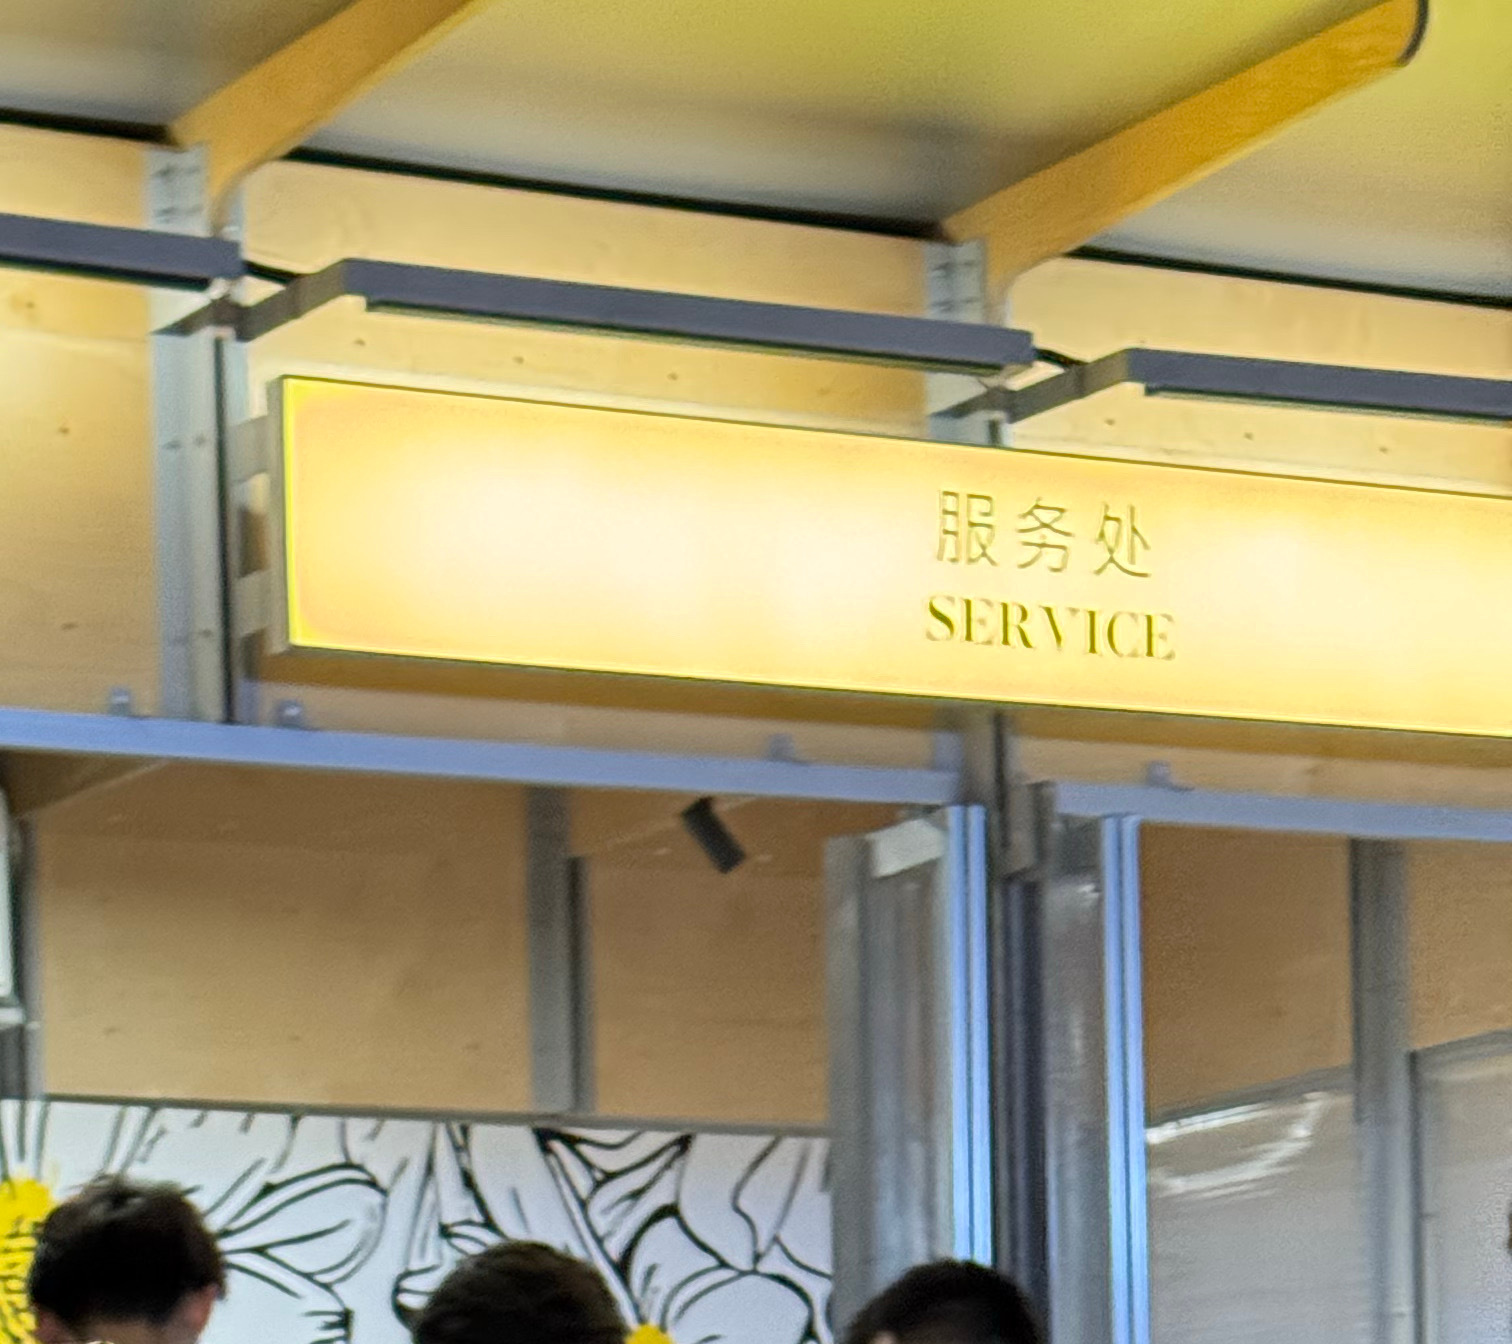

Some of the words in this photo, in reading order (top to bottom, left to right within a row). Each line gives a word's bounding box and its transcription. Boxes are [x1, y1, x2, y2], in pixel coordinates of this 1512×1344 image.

[937, 488, 1152, 578] 服务处
[925, 595, 1176, 660] SERVICE
